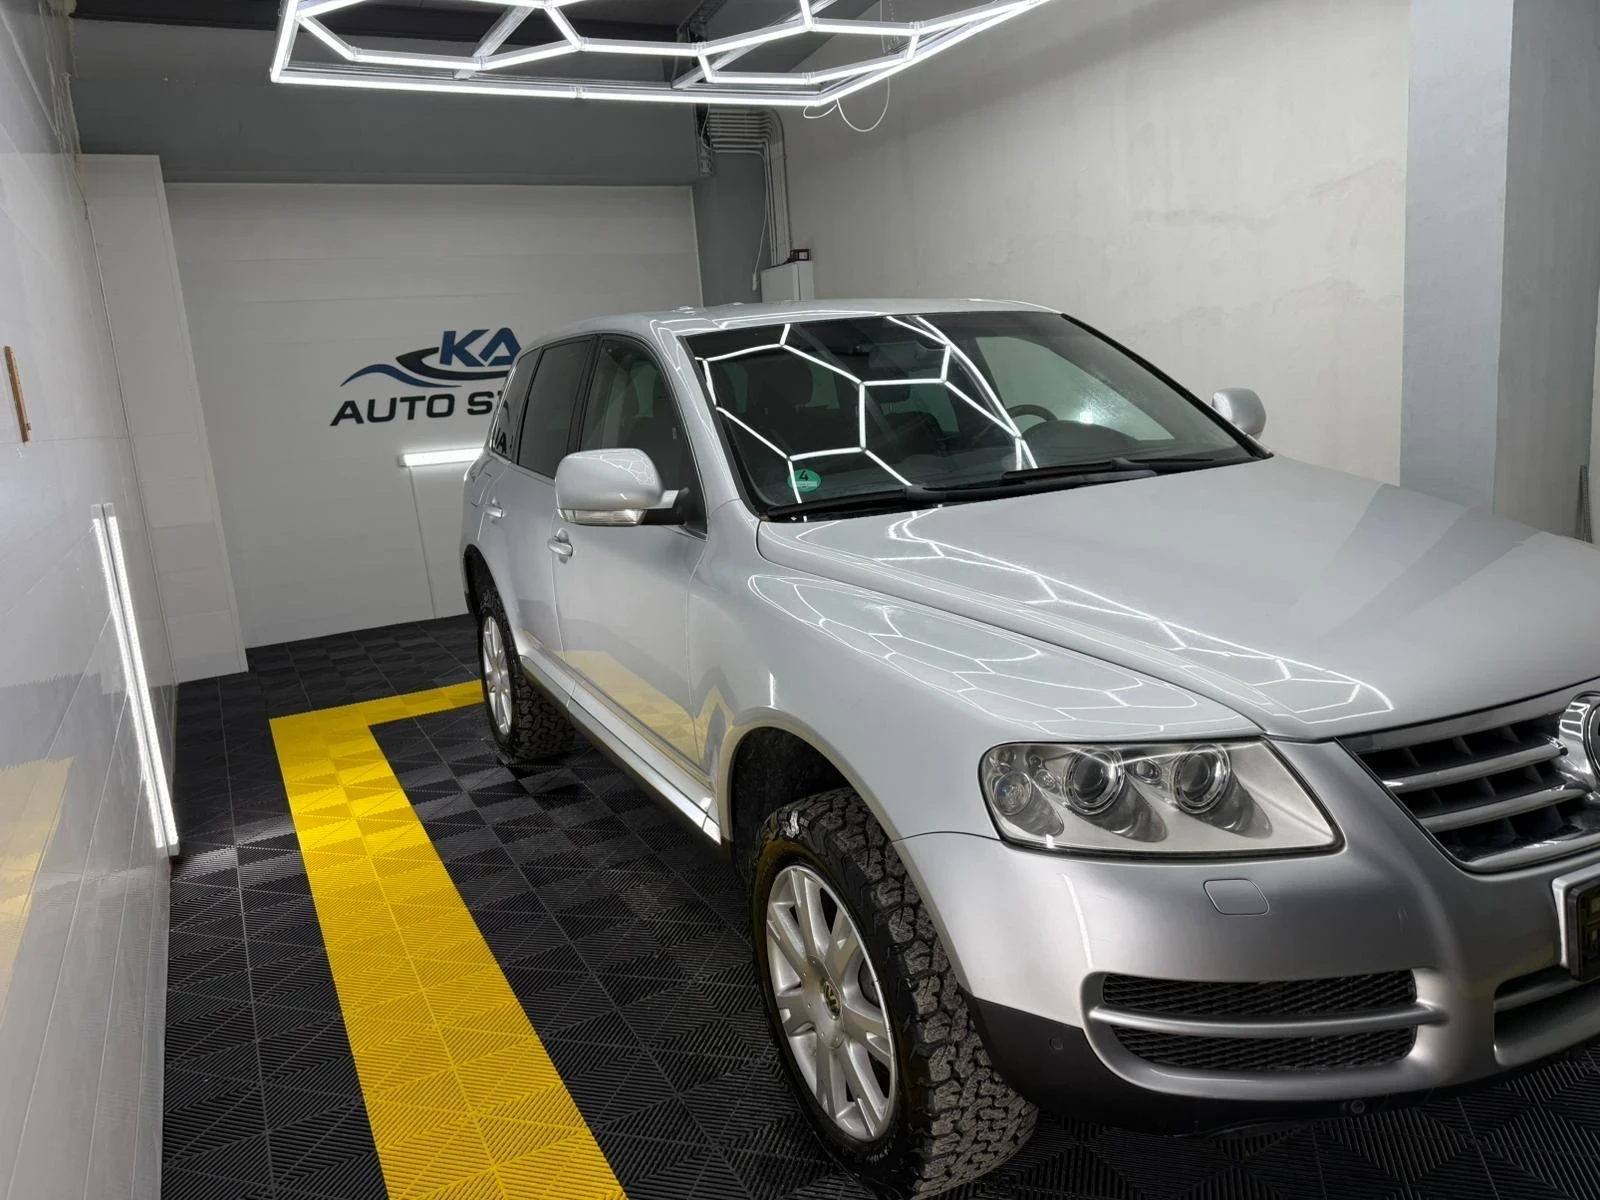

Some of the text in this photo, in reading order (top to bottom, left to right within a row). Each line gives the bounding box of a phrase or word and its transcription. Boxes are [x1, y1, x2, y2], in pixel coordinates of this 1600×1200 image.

[439, 327, 522, 368] KA
[329, 390, 503, 427] AUTO S
[799, 470, 809, 481] 4
